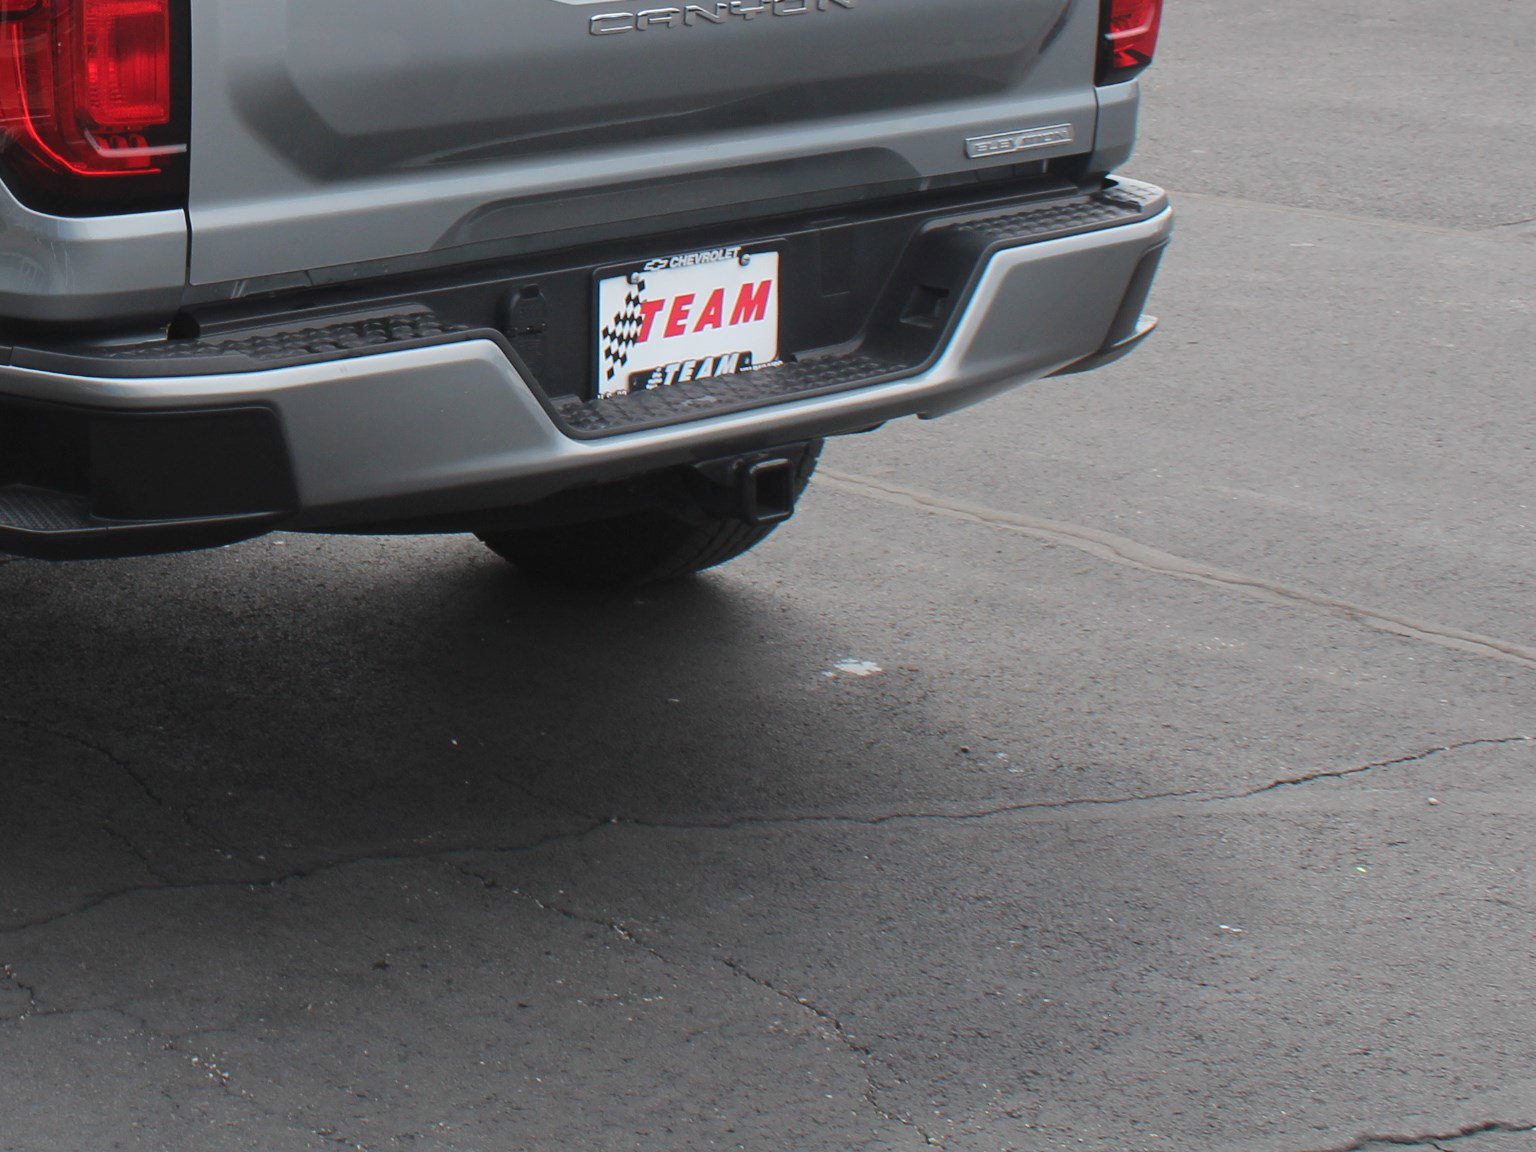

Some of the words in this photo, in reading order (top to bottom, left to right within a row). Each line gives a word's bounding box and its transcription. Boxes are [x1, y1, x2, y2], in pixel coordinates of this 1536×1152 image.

[669, 246, 742, 268] CHEVROLET
[636, 279, 772, 344] TEAM
[663, 352, 740, 386] TEAM
